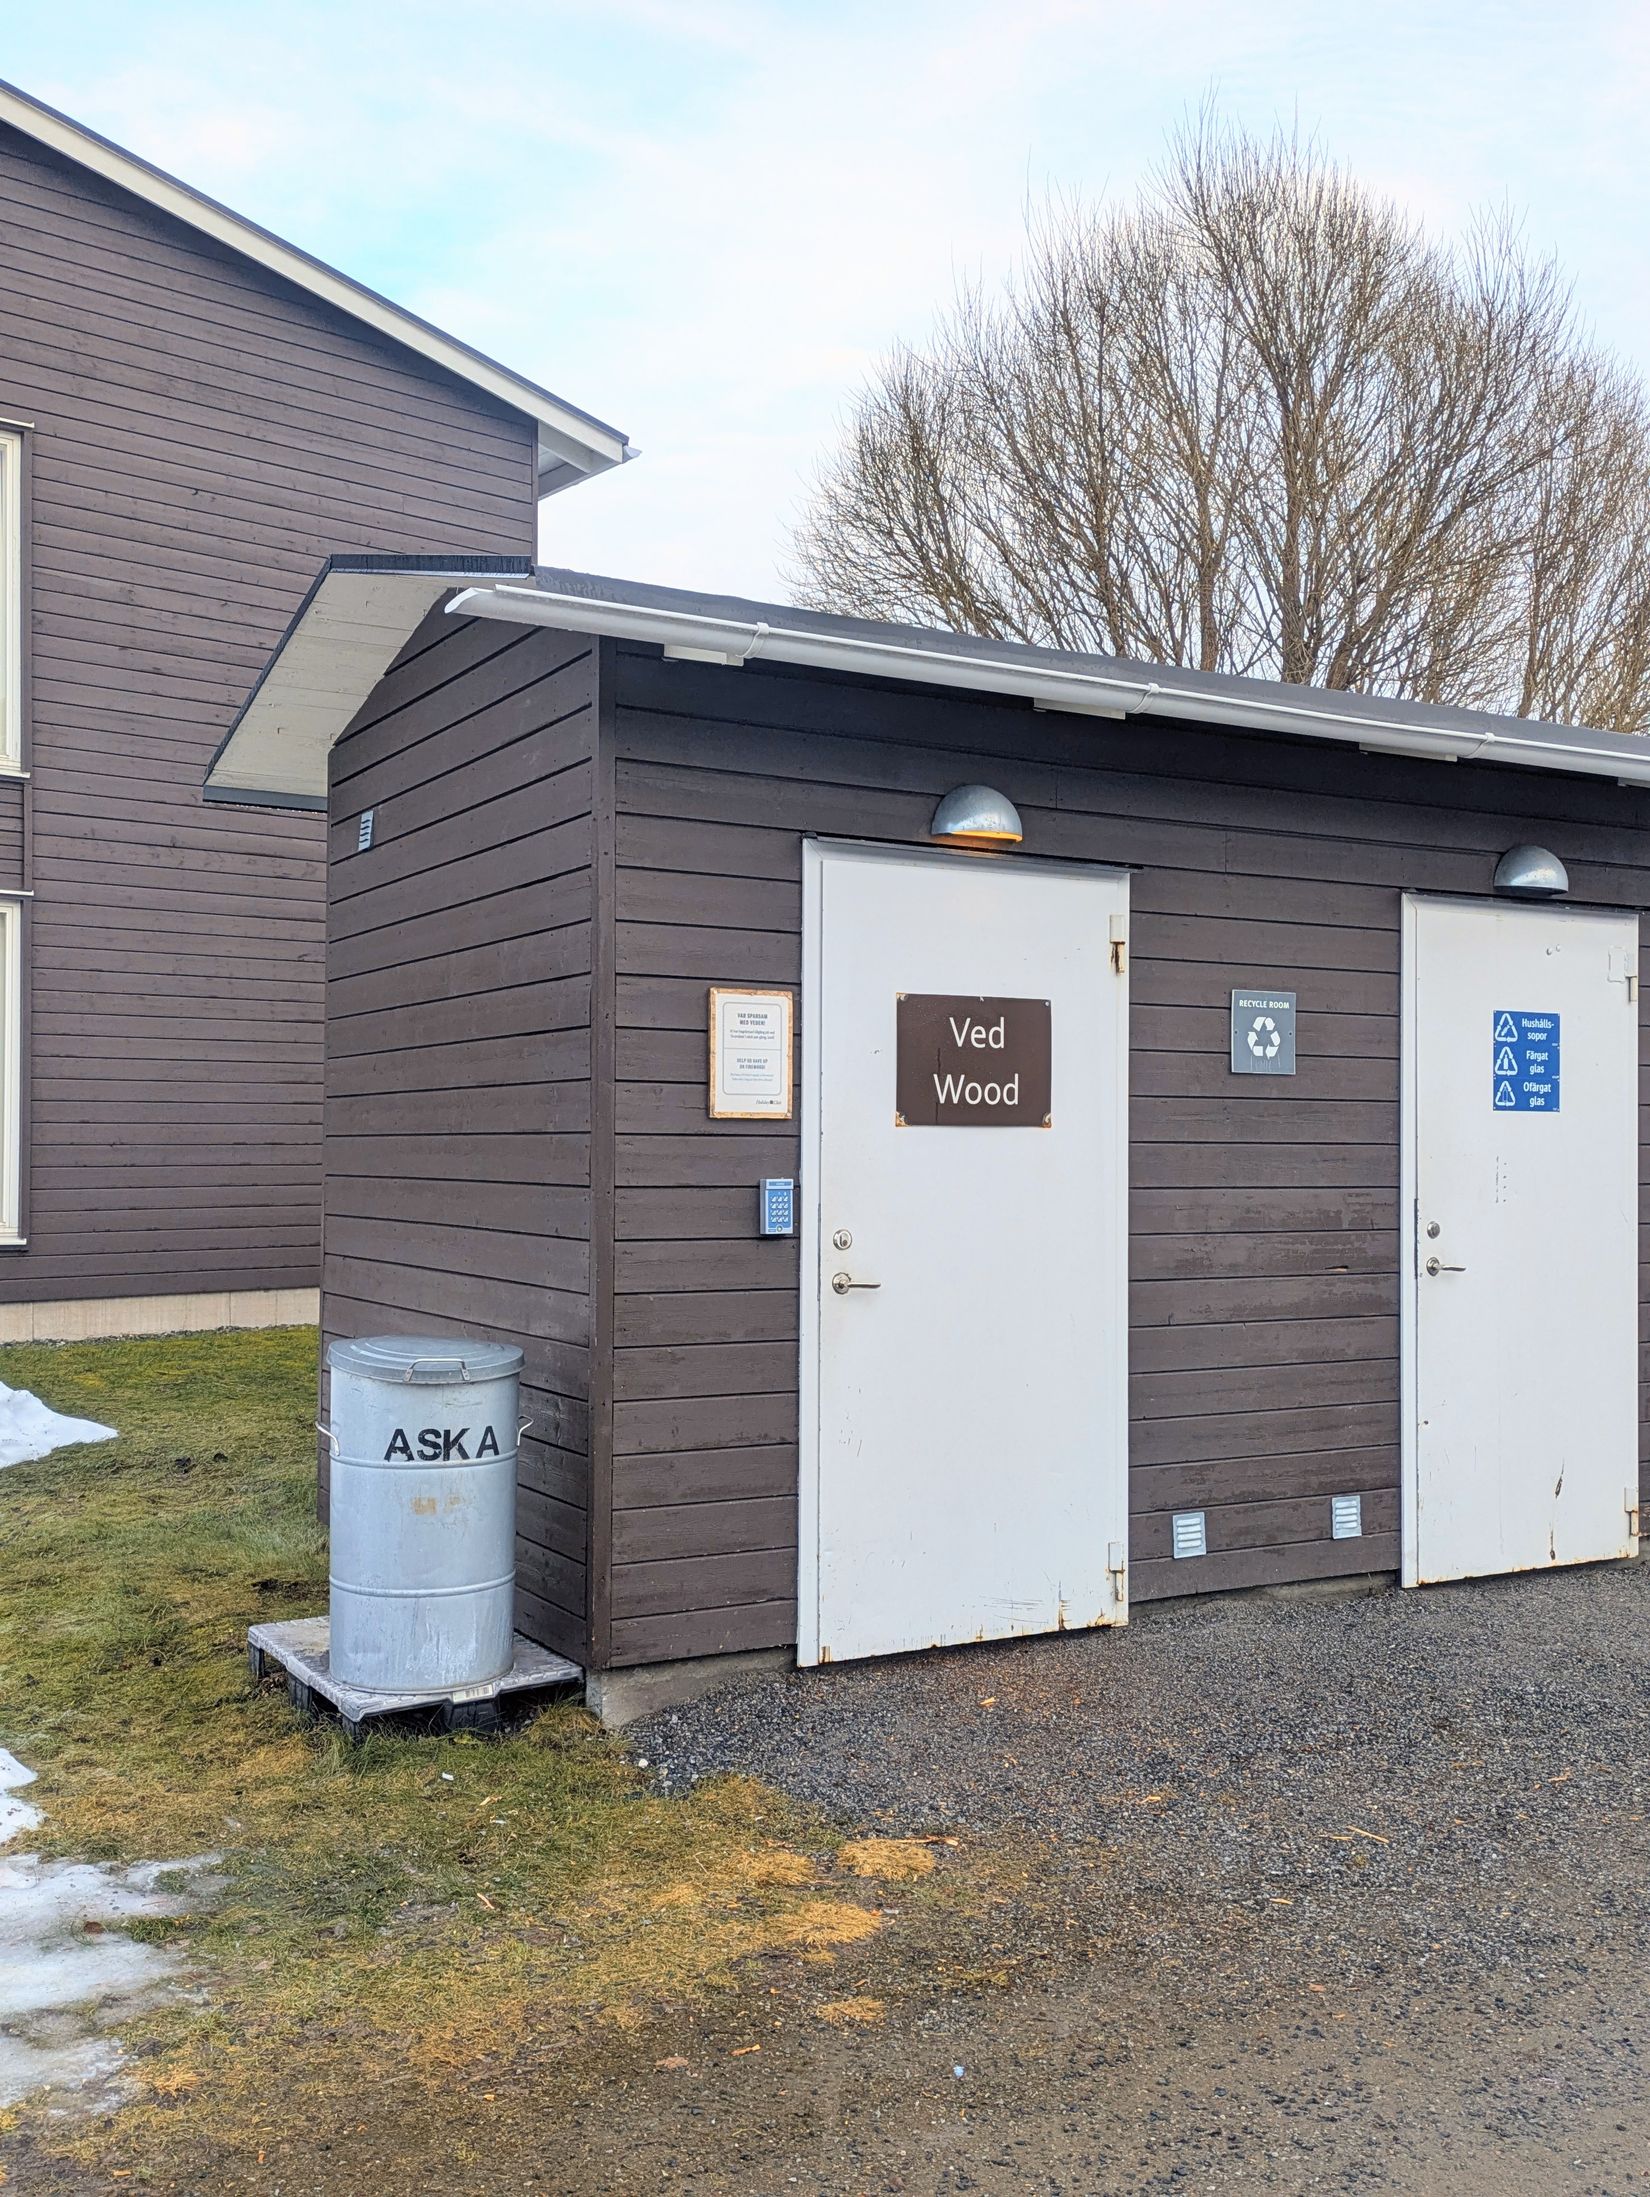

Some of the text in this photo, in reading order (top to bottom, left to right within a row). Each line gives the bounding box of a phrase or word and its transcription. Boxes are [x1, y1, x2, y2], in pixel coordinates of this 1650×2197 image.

[1239, 999, 1290, 1009] RECYCLE ROOM
[1521, 1018, 1554, 1029] Hushålls-
[949, 1016, 1005, 1049] Ved
[1527, 1032, 1548, 1041] sopor
[1526, 1050, 1549, 1062] Färgat
[1529, 1064, 1545, 1075] glas
[933, 1073, 1019, 1105] Wood
[1523, 1081, 1552, 1094] Ofärgat
[1529, 1095, 1545, 1107] glas
[383, 1425, 500, 1462] ASKA
